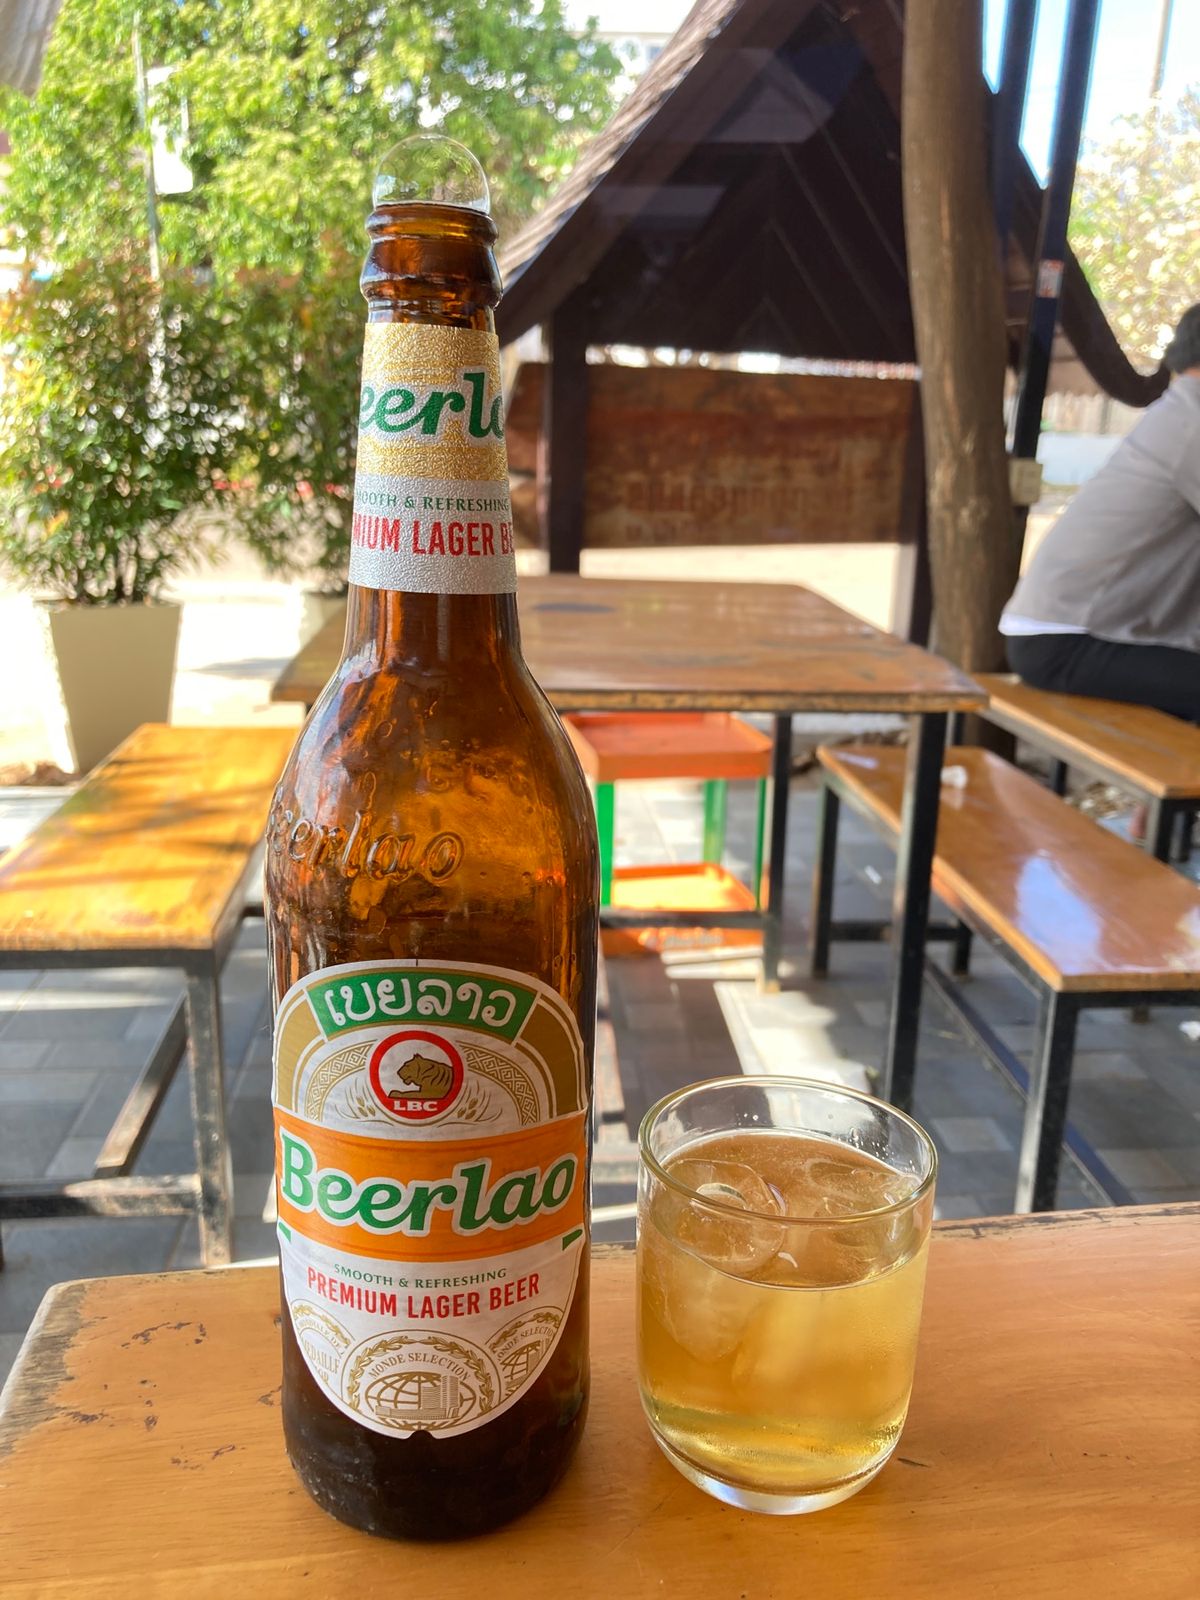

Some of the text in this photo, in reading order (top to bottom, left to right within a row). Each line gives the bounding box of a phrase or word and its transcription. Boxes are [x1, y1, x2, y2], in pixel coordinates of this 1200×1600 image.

[404, 495, 415, 509] &
[423, 496, 509, 512] REFRESHING
[413, 519, 495, 556] LAGER
[324, 977, 516, 1027] ເບຍລາວ
[393, 1100, 438, 1111] LBC
[279, 1131, 576, 1232] Beerlao
[333, 1263, 507, 1288] SMOOTH & REFRESHING
[307, 1266, 540, 1319] PREMIUM LAGER BEER
[368, 1352, 471, 1381] MONDE SELECTION
